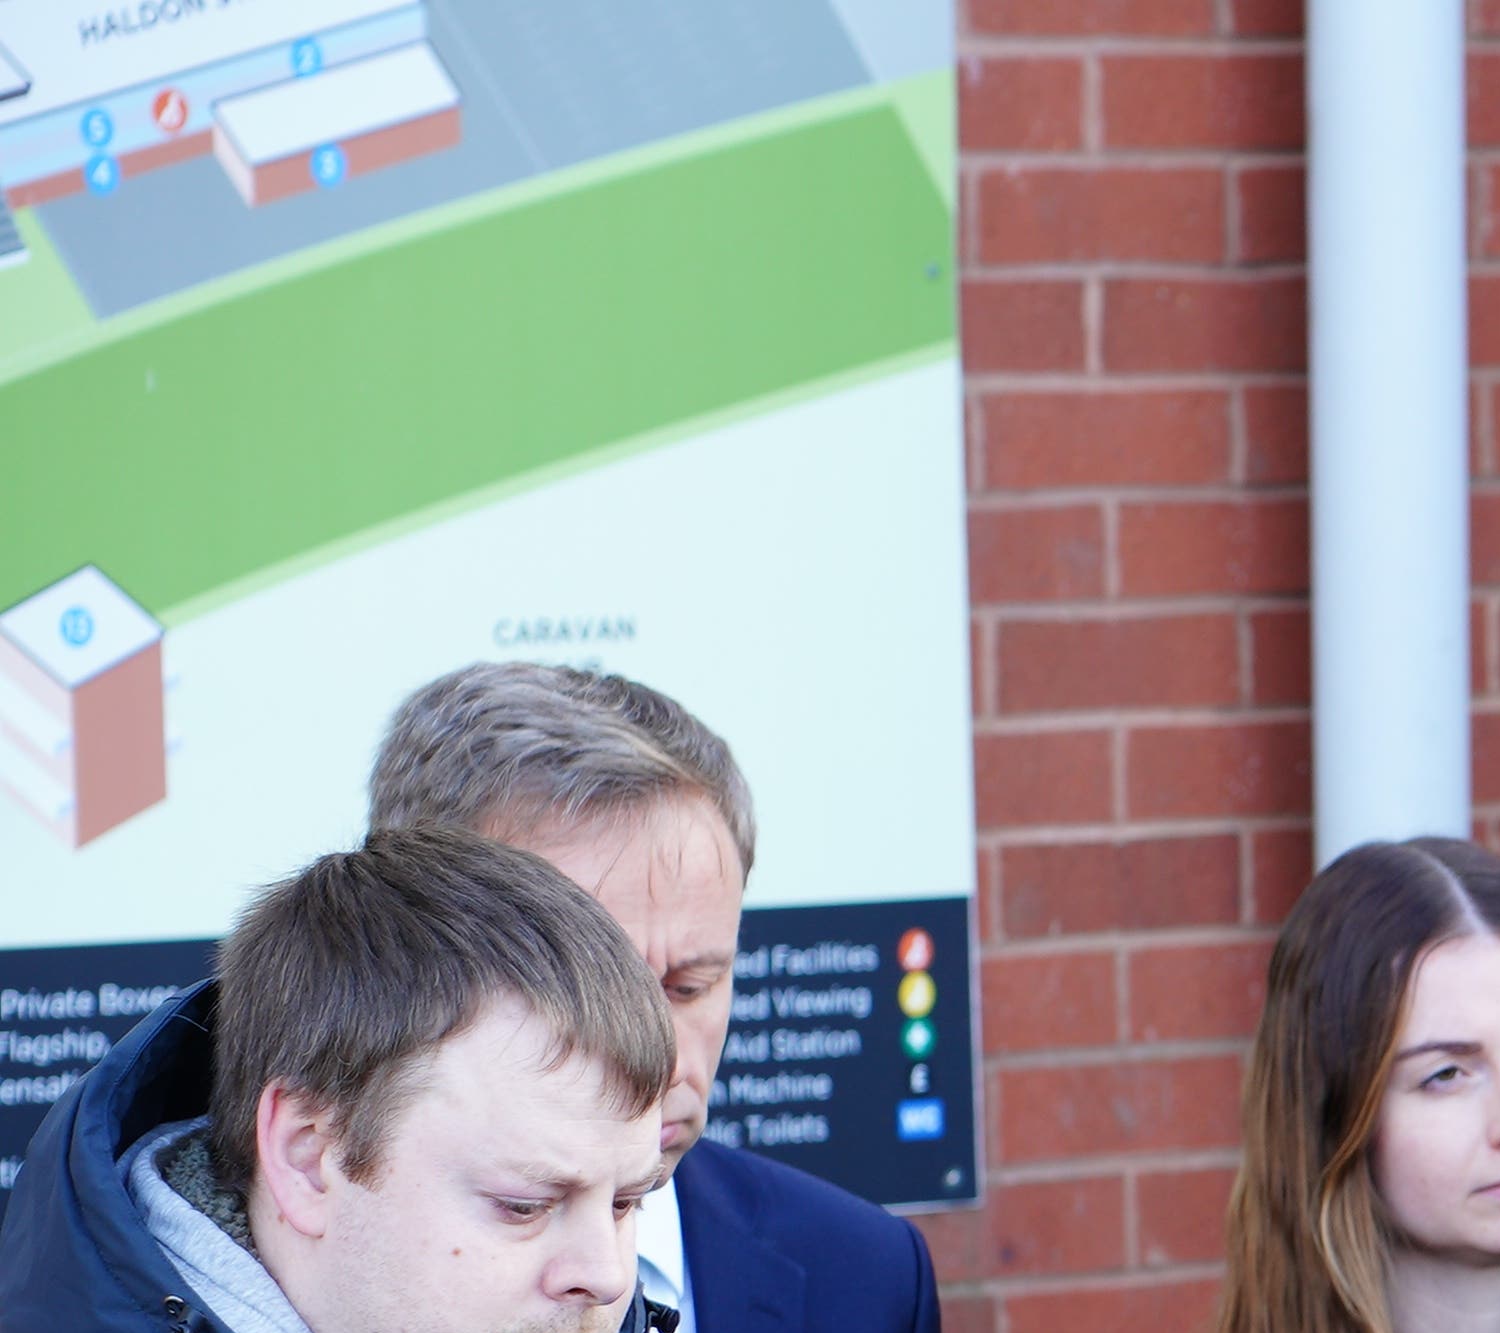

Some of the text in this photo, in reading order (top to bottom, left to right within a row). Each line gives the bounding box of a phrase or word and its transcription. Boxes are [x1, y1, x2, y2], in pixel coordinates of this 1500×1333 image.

[78, 0, 203, 46] HALDON
[493, 615, 636, 648] CARAVAN
[771, 942, 880, 976] Facilities
[0, 987, 97, 1021] Private
[770, 984, 874, 1019] Viewing
[723, 1027, 862, 1063] Aid Station
[729, 1071, 833, 1104] Machine
[745, 1112, 830, 1146] Toilets
